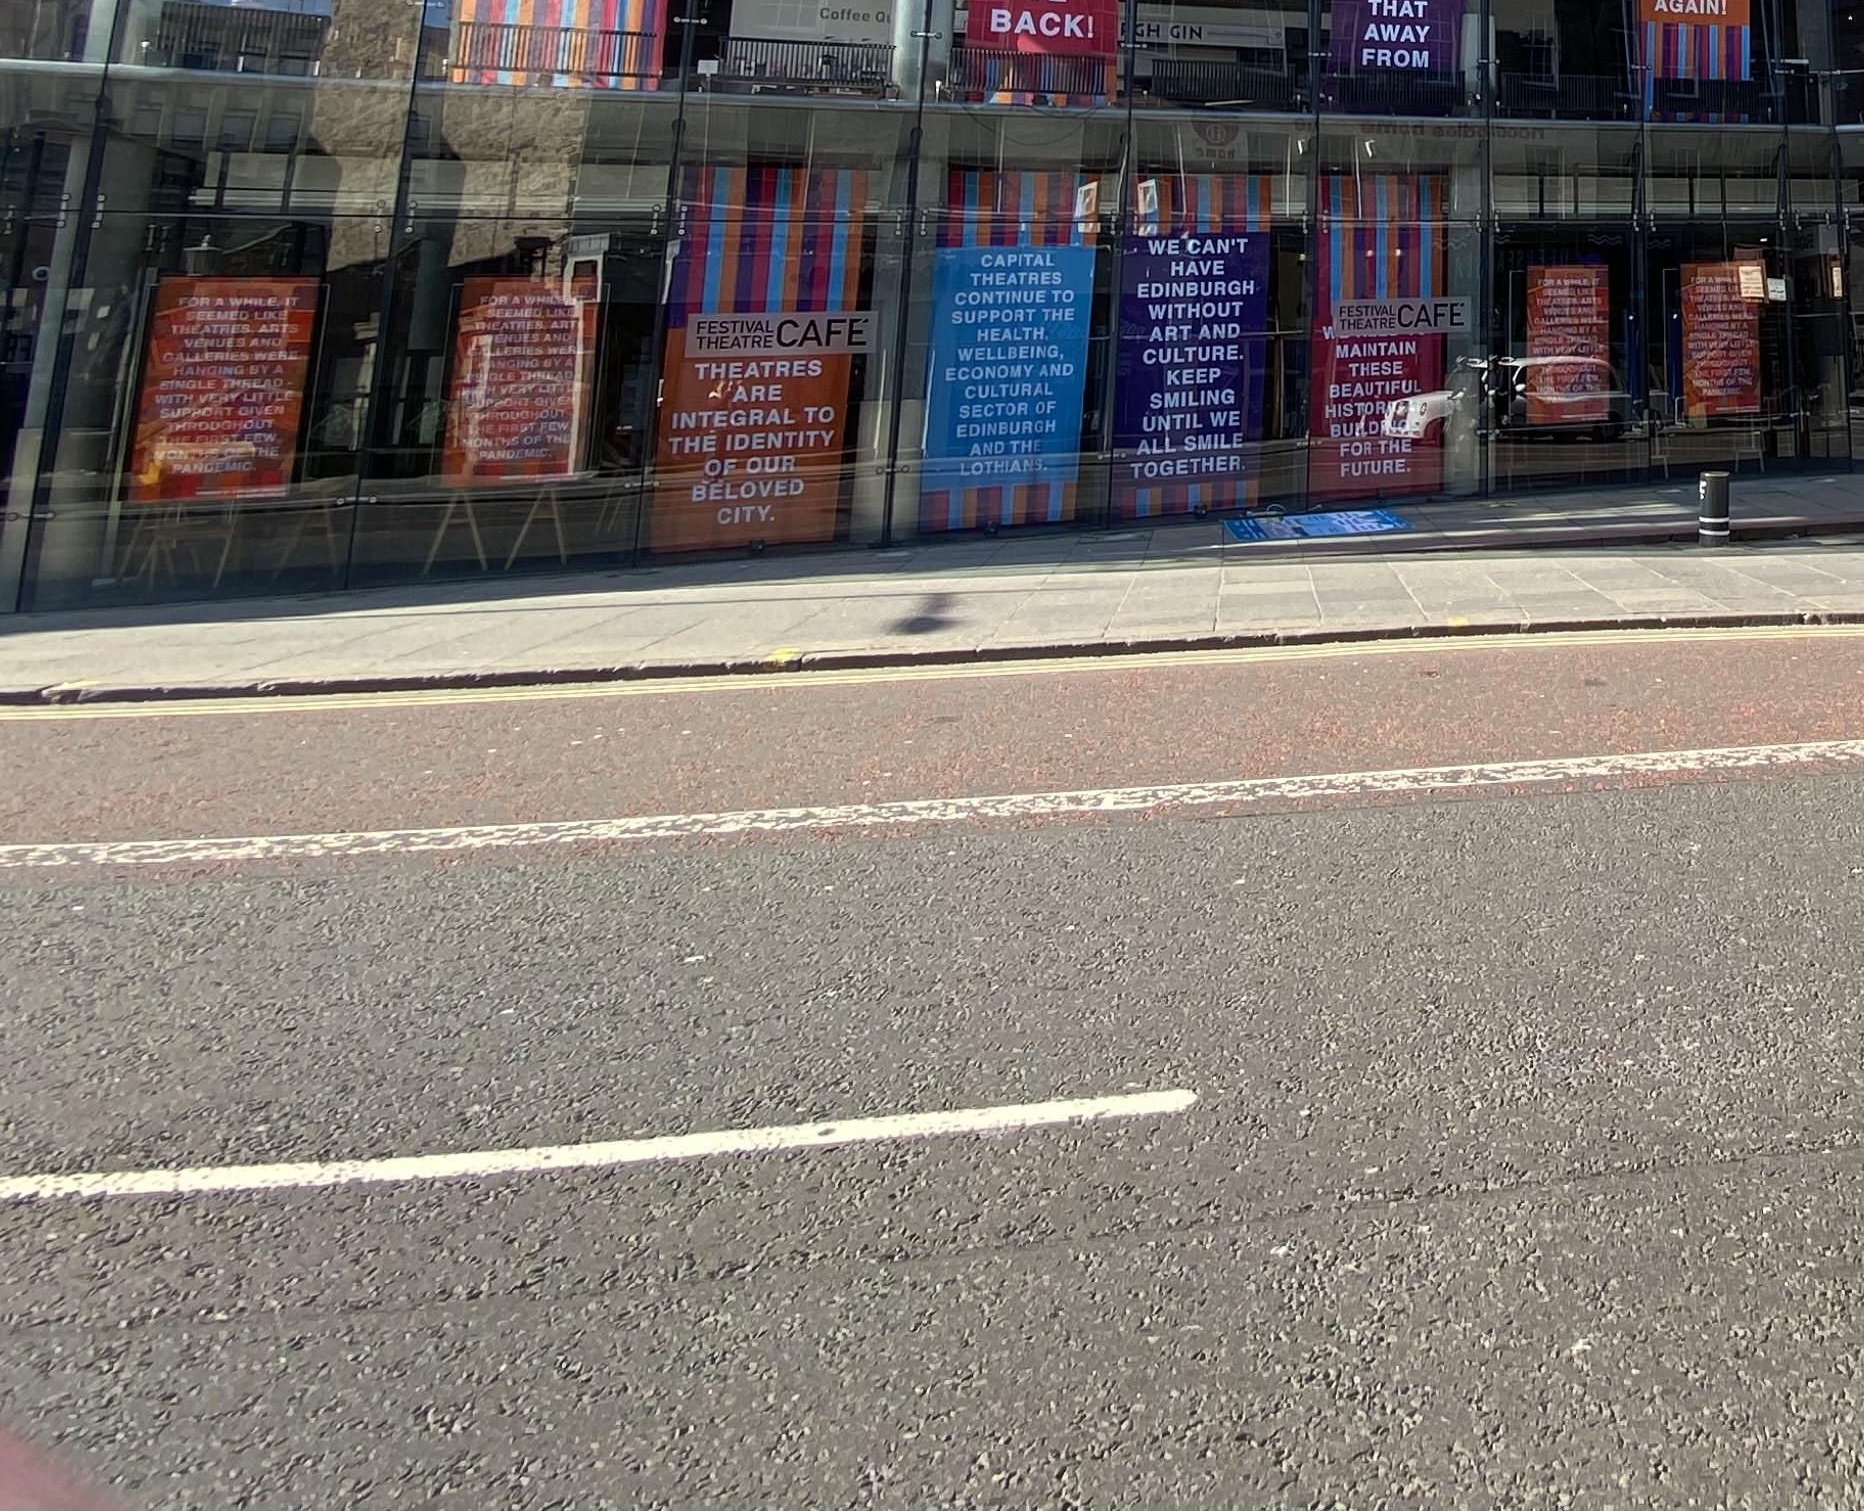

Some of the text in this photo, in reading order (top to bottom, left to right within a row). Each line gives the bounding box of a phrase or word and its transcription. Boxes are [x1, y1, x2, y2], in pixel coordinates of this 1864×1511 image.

[820, 8, 870, 22] Coffee
[991, 9, 1094, 38] BACK!
[1169, 26, 1202, 39] GIN
[1362, 48, 1430, 68] FROM
[981, 254, 1055, 268] CAPITAL
[1171, 260, 1224, 277] HAVE
[971, 272, 1061, 286] THEATRES
[955, 290, 1074, 306] CONTINUE TO
[1137, 281, 1255, 299] EDINBURGH
[952, 308, 1075, 324] SUPPORT THE
[1148, 302, 1243, 320] WITHOUT
[696, 320, 774, 334] FESTIVAL
[697, 335, 773, 350] THEATRE
[1336, 341, 1416, 358] MAINTAIN
[1143, 345, 1243, 364] CULTURE.
[695, 359, 822, 380] THEATRES
[1167, 368, 1222, 385] KEEP
[1349, 361, 1403, 377] THESE
[732, 384, 782, 403] ARE
[965, 384, 1053, 400] CULTURAL
[1329, 380, 1421, 398] BEAUTIFUL
[1150, 390, 1235, 410] SMILING
[672, 406, 835, 429] INTEGRAL TO
[957, 420, 1056, 438] EDINBURGH
[726, 430, 835, 451] IDENTITY
[1341, 459, 1411, 477] FUTURE.
[717, 505, 775, 524] CITY.
